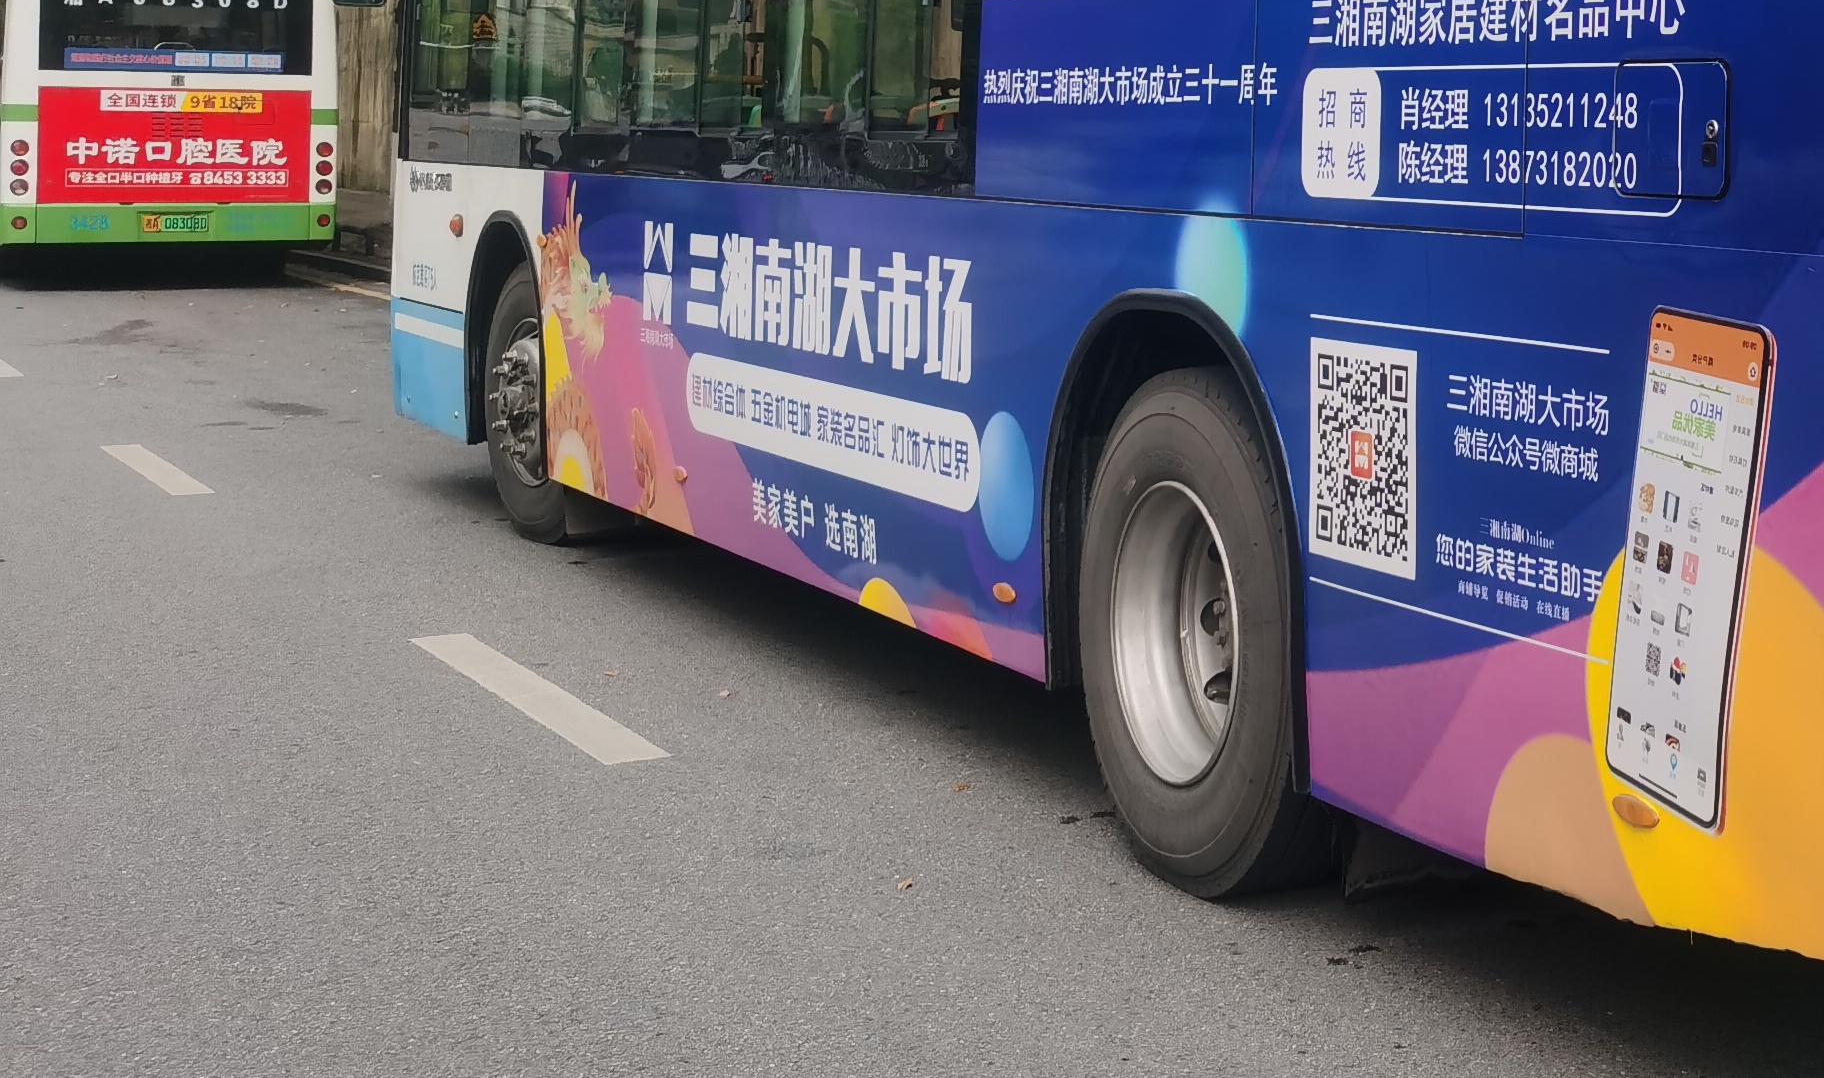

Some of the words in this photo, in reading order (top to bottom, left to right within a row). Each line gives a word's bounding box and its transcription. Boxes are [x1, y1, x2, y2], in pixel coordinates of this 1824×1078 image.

[107, 93, 177, 108] 全国连锁
[983, 62, 1278, 106] 热烈庆祝三湘南湖大市场成立三十一周年
[1318, 88, 1368, 129] 招商
[1400, 87, 1469, 130] 肖经理
[1484, 91, 1638, 129] 13135211248
[66, 137, 288, 166] 中诺口腔医院
[1316, 140, 1367, 182] 热线
[1398, 139, 1469, 184] 陈经理
[1483, 148, 1637, 189] 13873182020
[247, 170, 287, 185] 3333
[687, 232, 973, 385] 三湘南湖大市场
[692, 373, 747, 419] 建材综合体
[751, 388, 812, 438] 五金机电城
[817, 404, 885, 460] 家装名品汇
[891, 422, 970, 482] 灯饰大世界
[1447, 374, 1609, 436] 三湘南湖大市场
[1453, 424, 1599, 482] 微信公众号微商城
[752, 478, 815, 539] 美家美户
[824, 503, 878, 565] 选南湖
[1436, 533, 1604, 603] 您的家装生活助手
